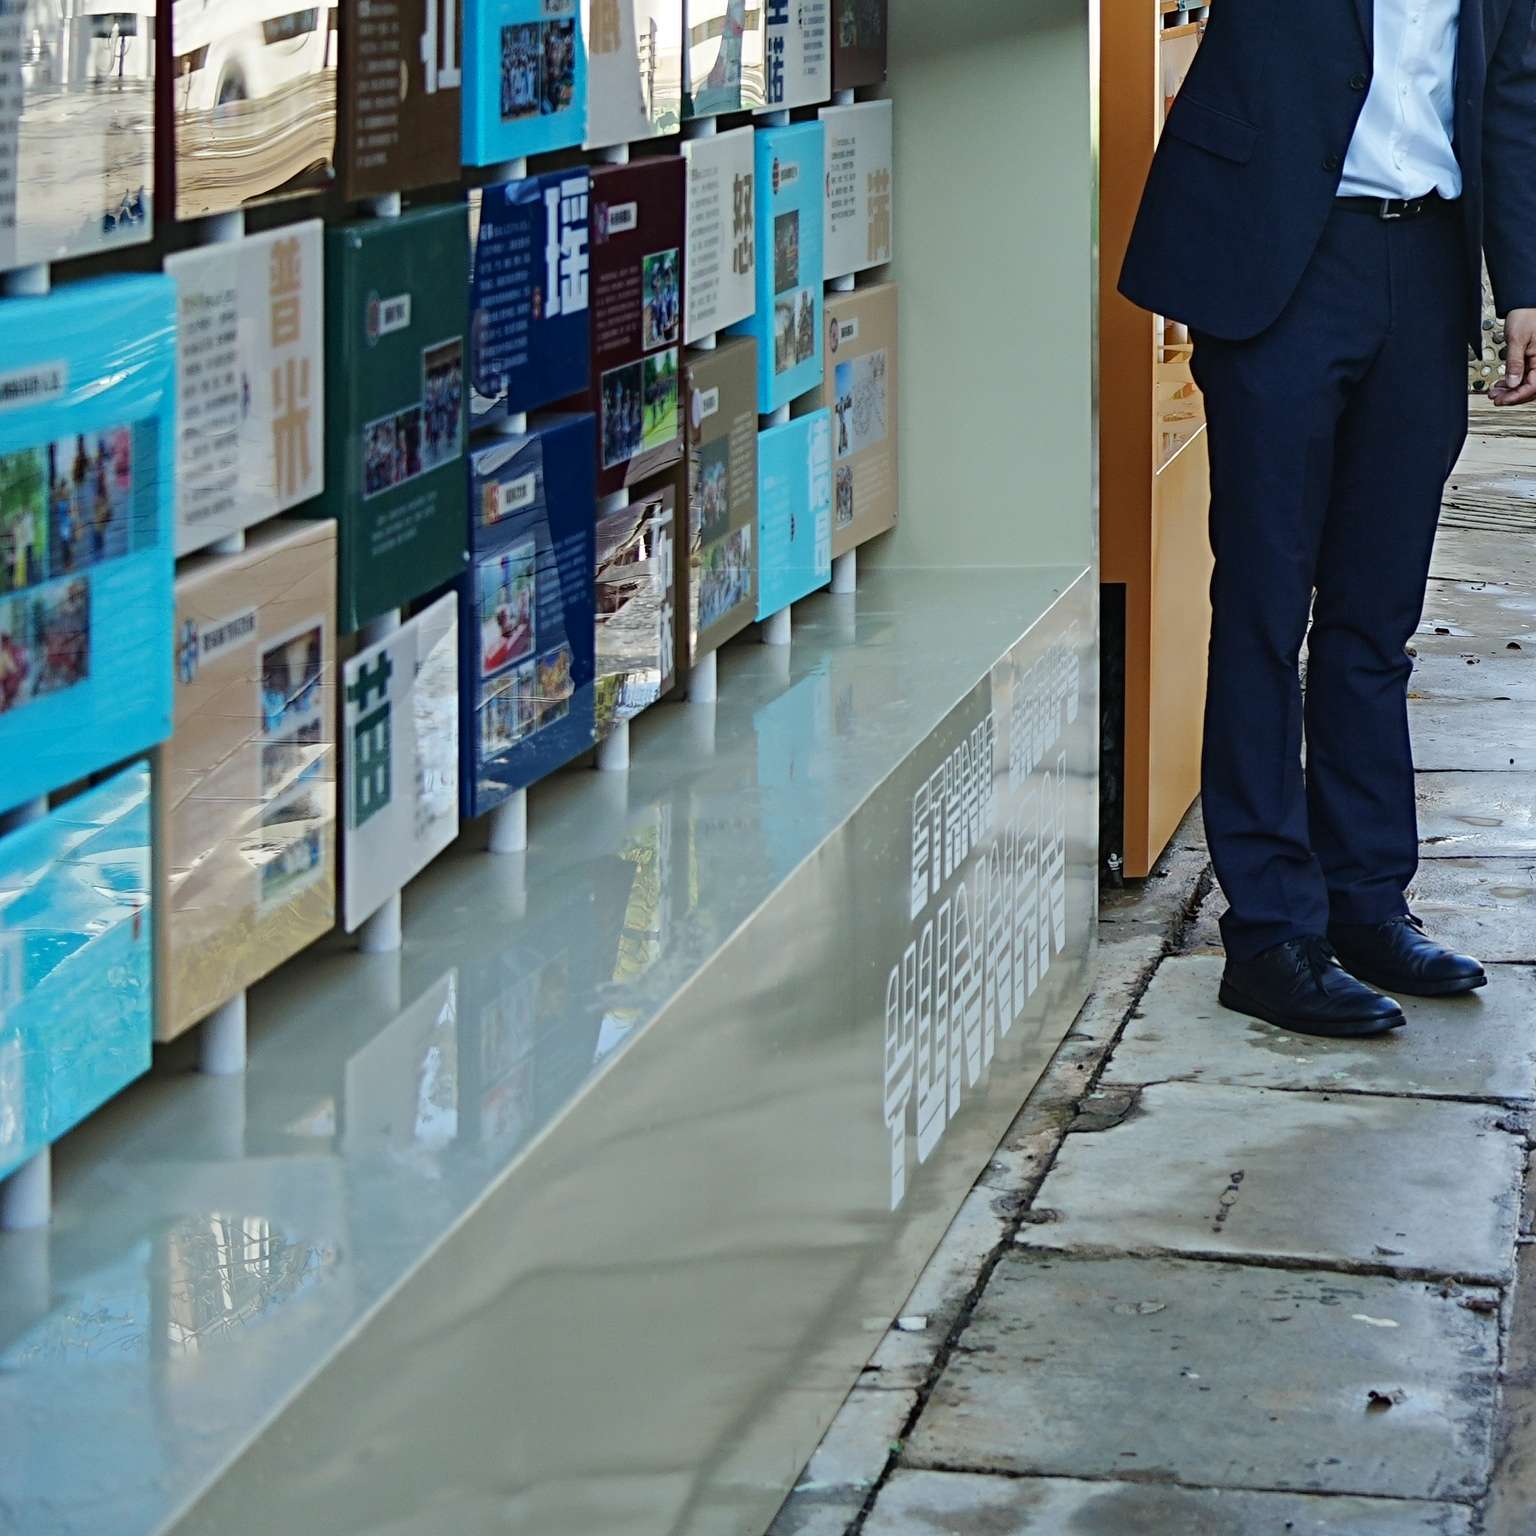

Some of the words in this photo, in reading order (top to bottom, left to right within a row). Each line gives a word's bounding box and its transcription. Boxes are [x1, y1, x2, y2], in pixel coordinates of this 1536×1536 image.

[545, 175, 589, 320] 瑶
[348, 650, 393, 829] 苗
[911, 710, 999, 921] ETHNIC
[884, 750, 1067, 1211] YUNNAN
